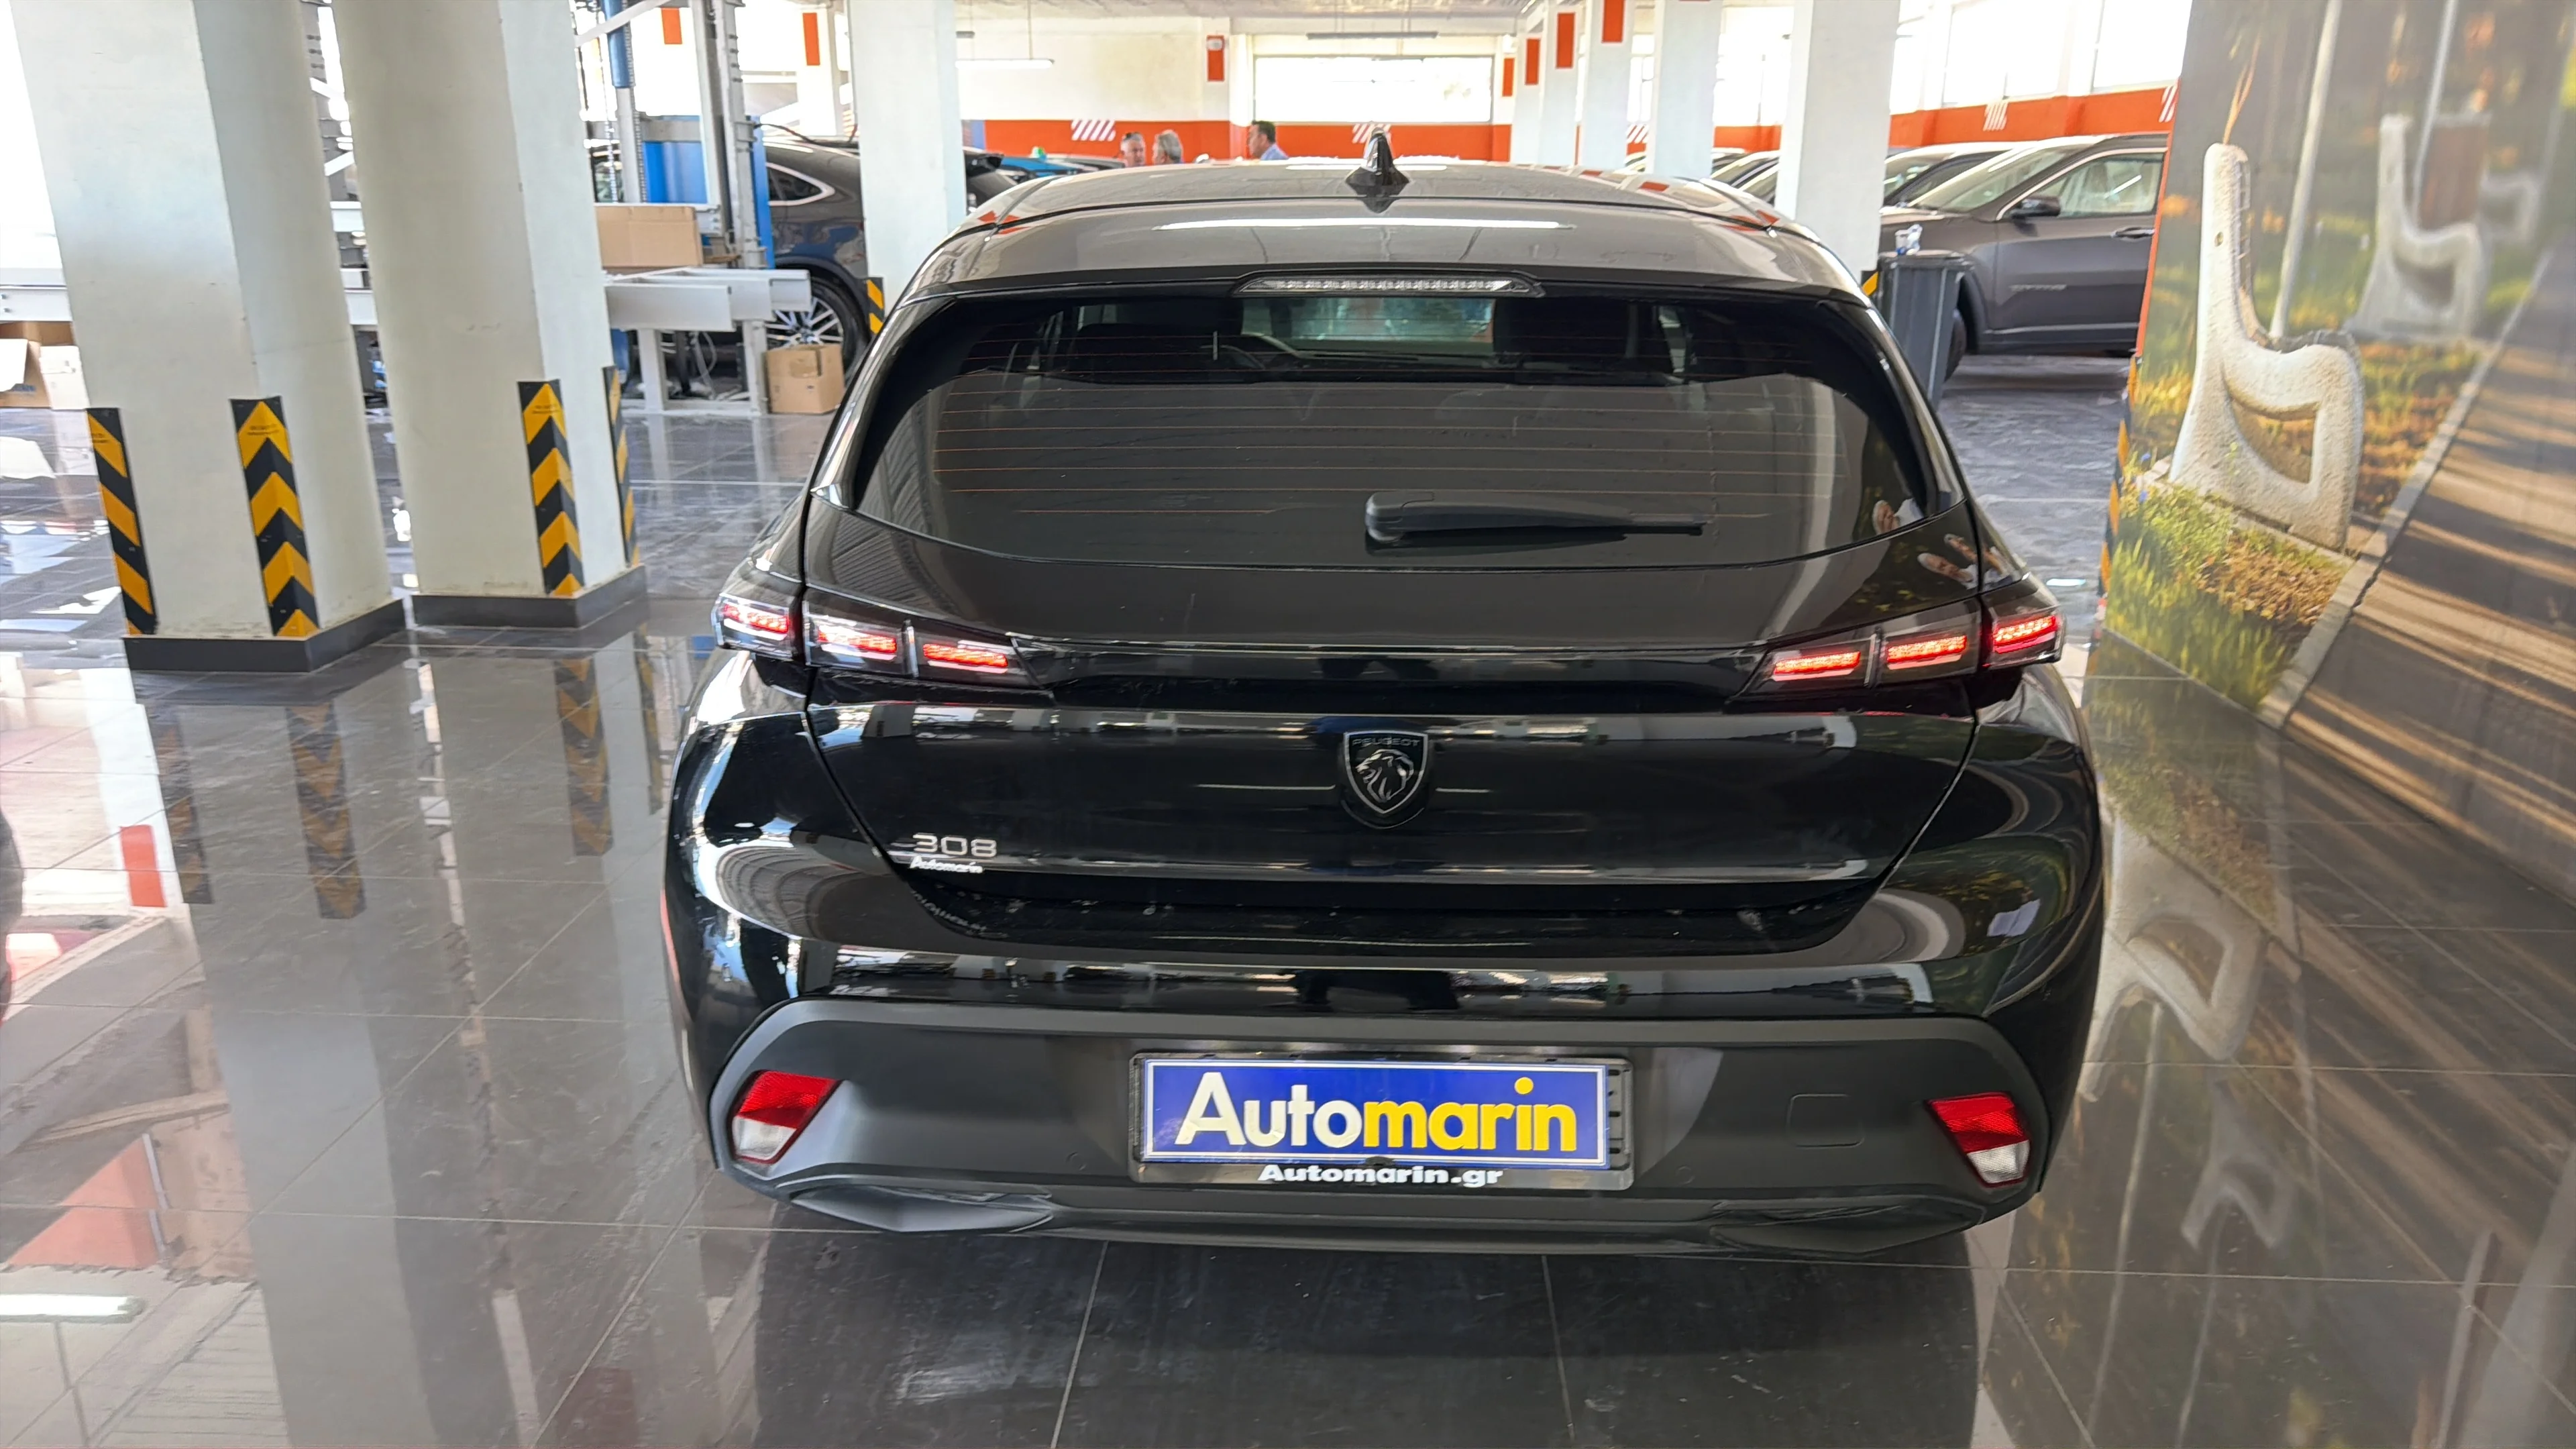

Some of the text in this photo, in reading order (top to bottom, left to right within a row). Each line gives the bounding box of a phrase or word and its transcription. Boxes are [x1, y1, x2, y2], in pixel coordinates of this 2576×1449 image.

[1352, 738, 1420, 747] PEUGEOT
[912, 834, 997, 857] 308
[1175, 1071, 1577, 1152] Automarin
[1258, 1164, 1503, 1188] Automarin.gr
